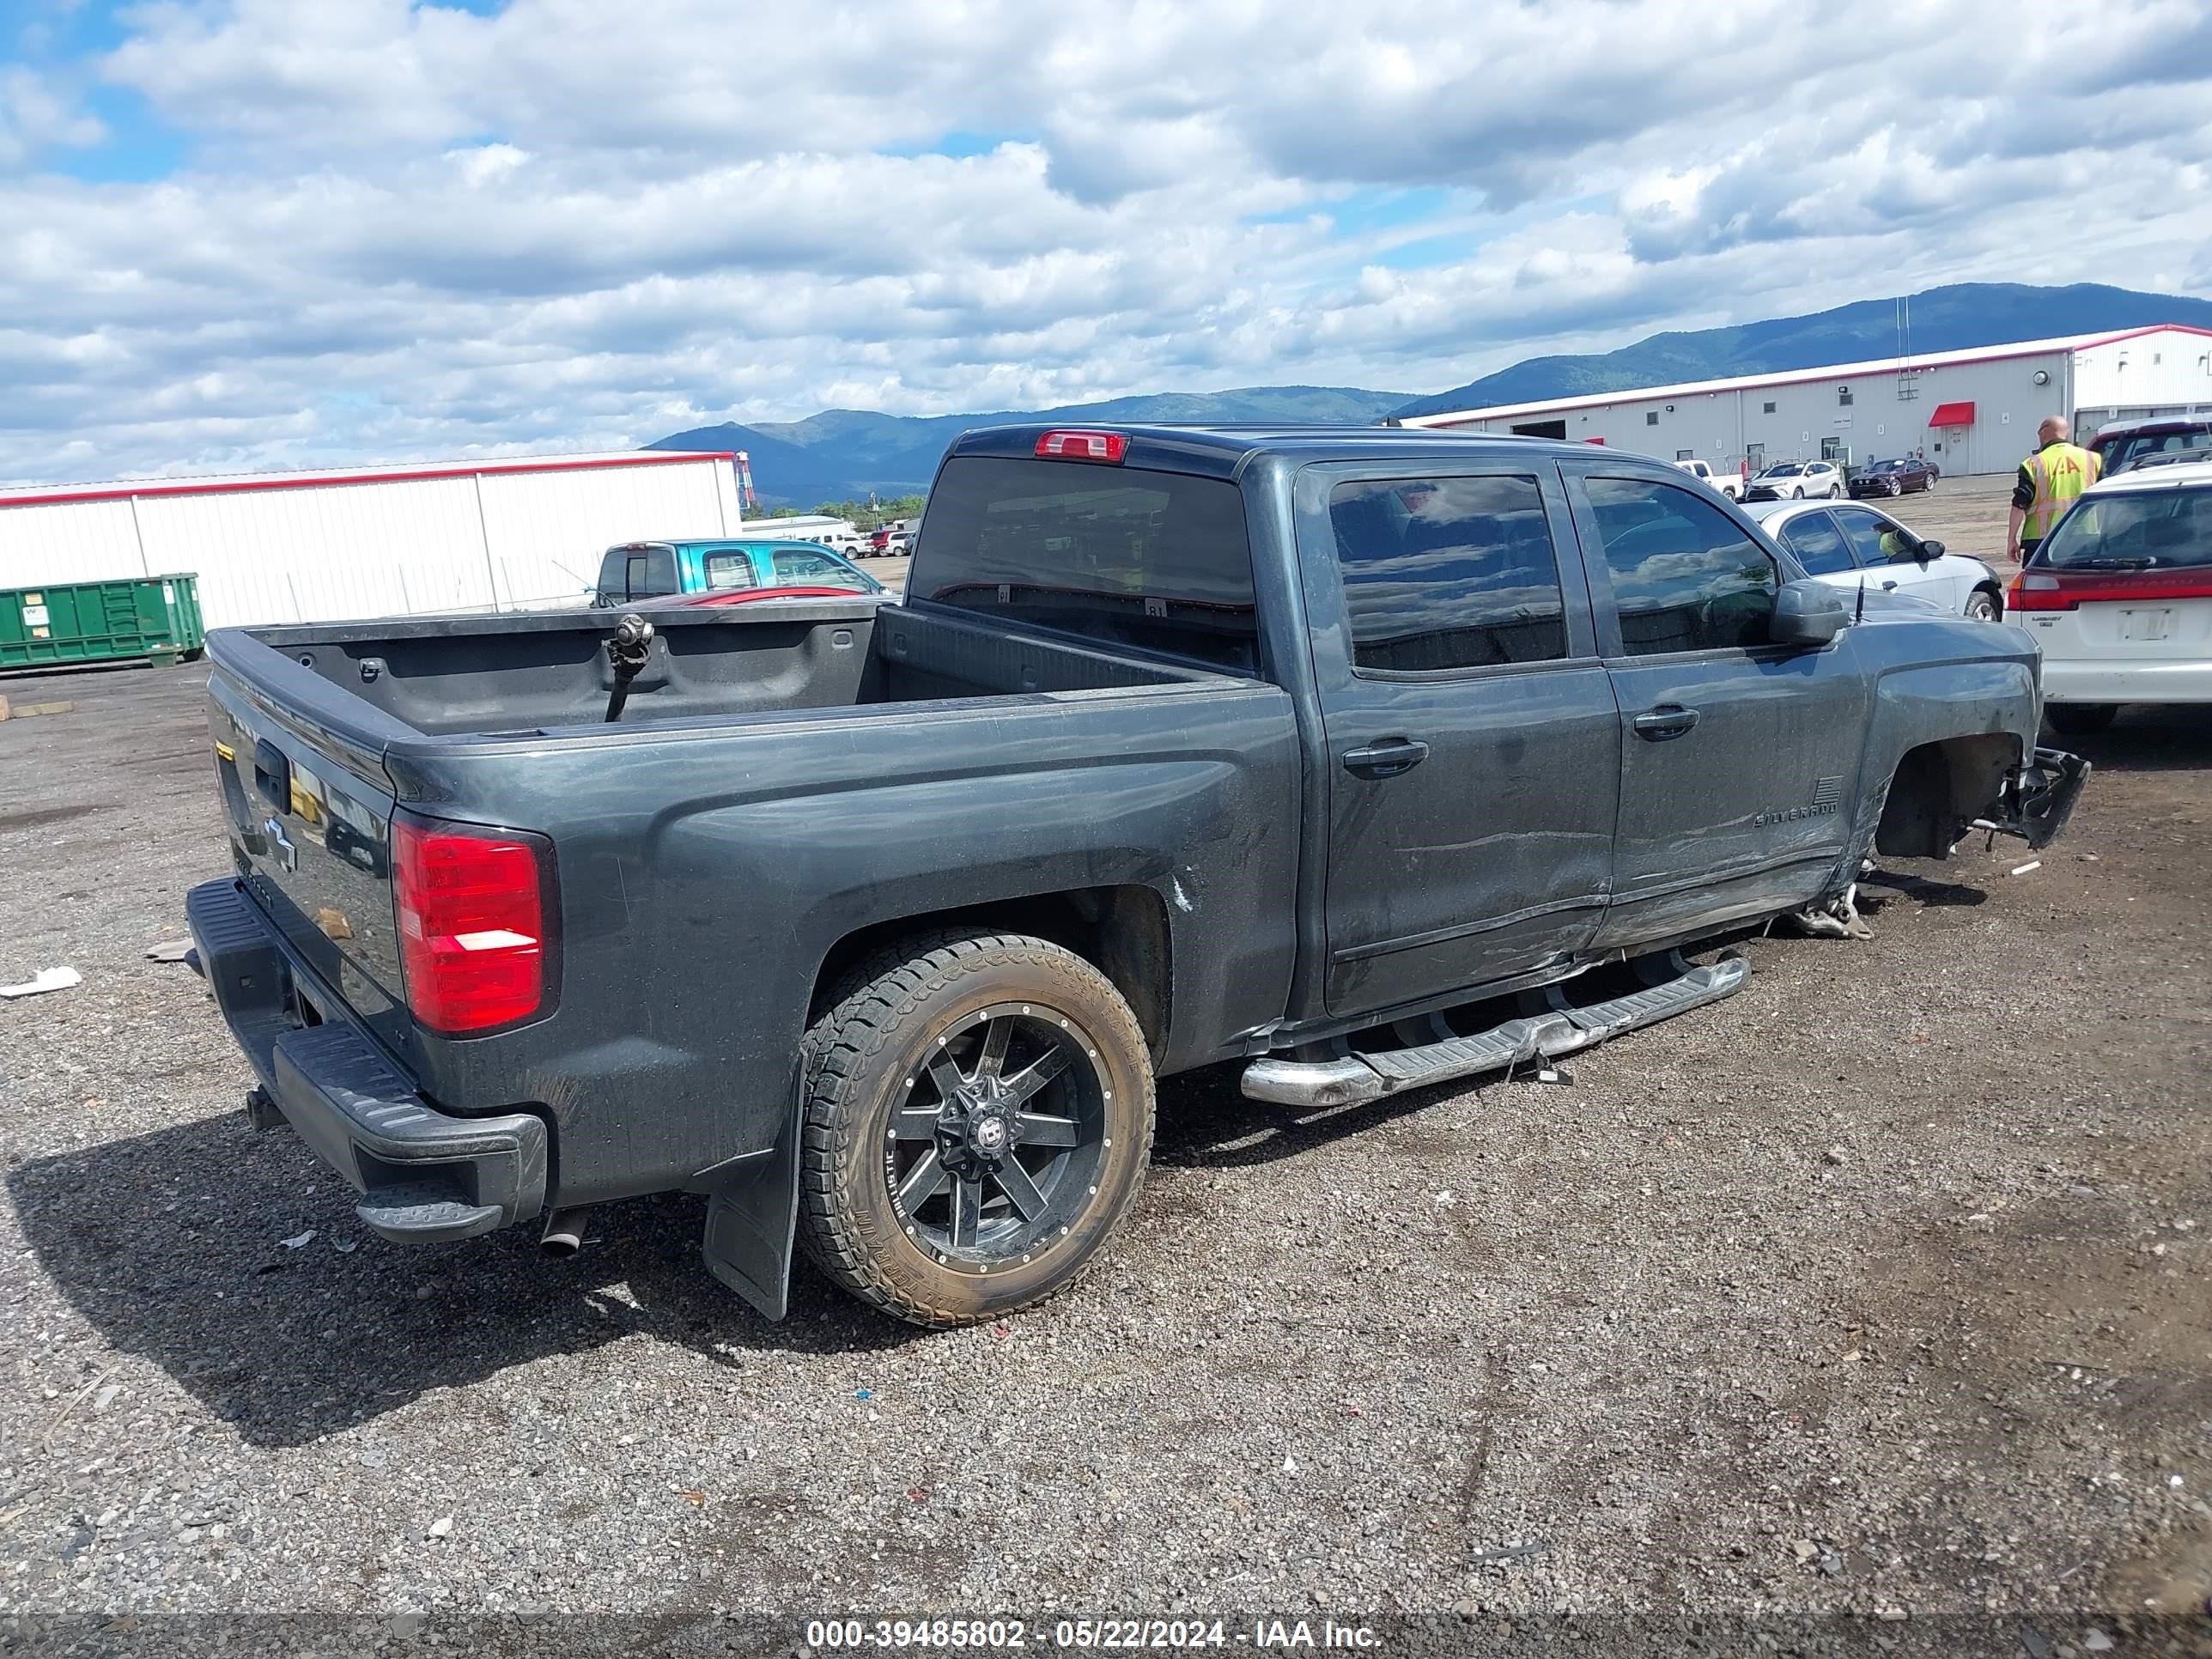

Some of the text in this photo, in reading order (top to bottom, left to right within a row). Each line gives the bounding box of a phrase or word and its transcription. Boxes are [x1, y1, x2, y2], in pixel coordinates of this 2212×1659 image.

[1753, 803, 1838, 829] SILVERADO
[885, 1150, 907, 1219] BALLISTIC
[854, 1209, 963, 1312] ALL TERRAIN
